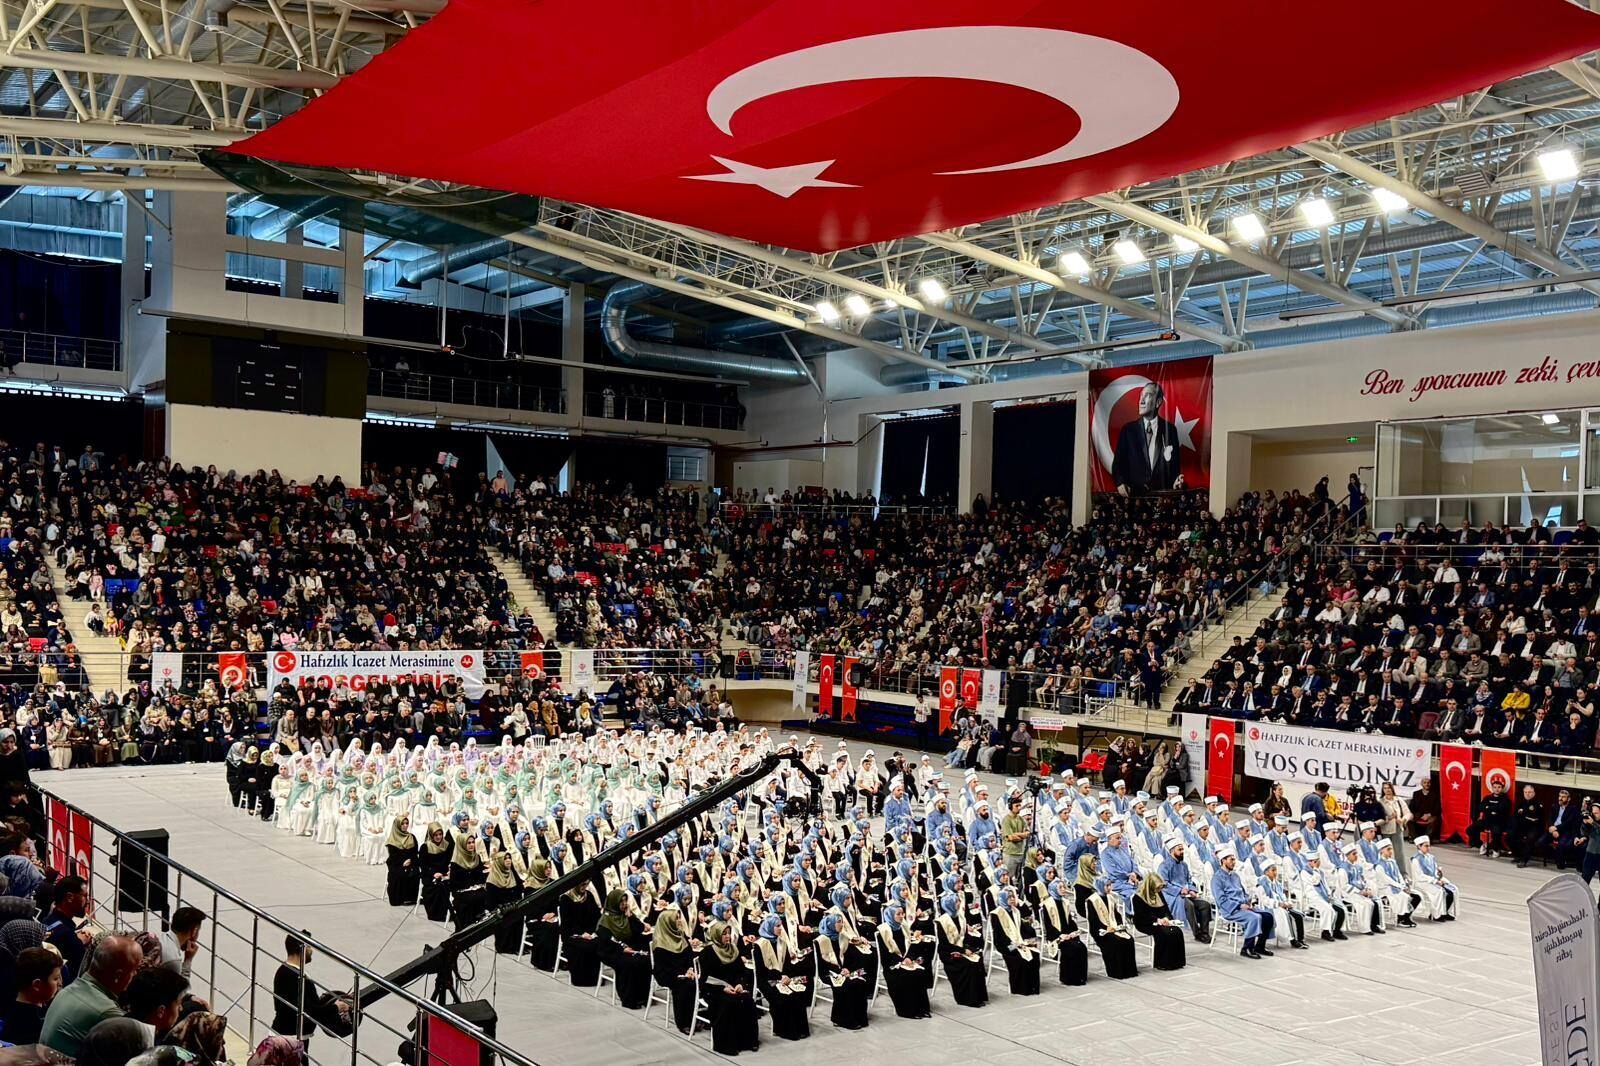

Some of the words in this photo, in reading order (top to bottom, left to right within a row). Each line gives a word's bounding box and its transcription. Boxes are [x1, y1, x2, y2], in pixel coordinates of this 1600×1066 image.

[1360, 368, 1405, 395] Ben
[1409, 369, 1508, 402] sporcunun
[1514, 356, 1559, 383] zeki,
[389, 653, 455, 668] Merasimine
[1261, 732, 1305, 746] HAFIZLIK
[1307, 736, 1342, 751] İCAZET
[1344, 743, 1412, 758] MERASİMİNE
[1255, 751, 1298, 778] HOŞ
[1304, 758, 1417, 788] GELDİNİZ
